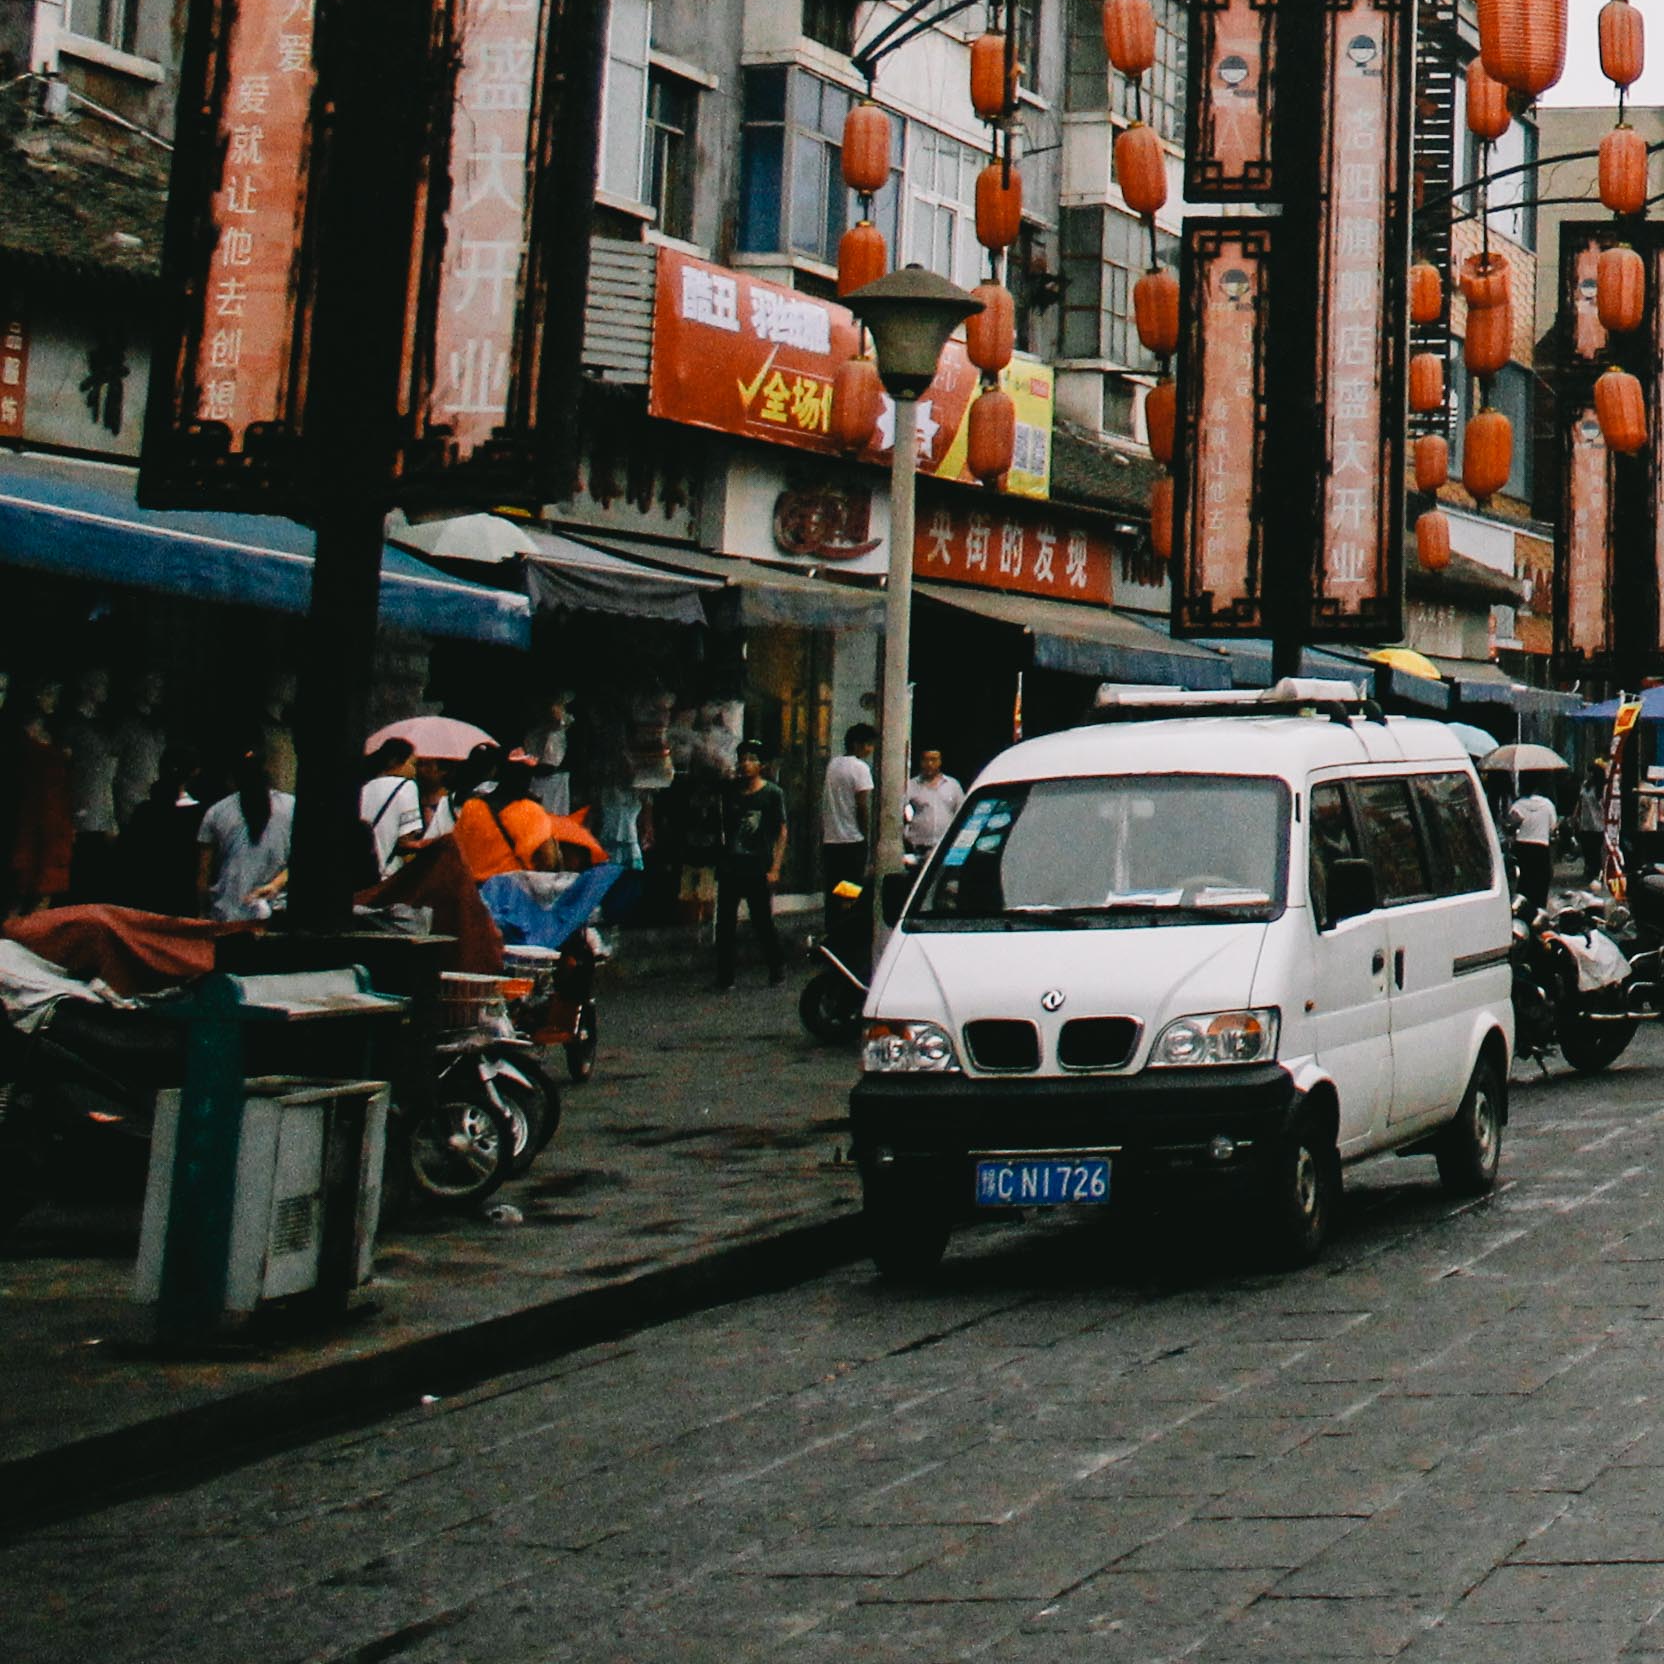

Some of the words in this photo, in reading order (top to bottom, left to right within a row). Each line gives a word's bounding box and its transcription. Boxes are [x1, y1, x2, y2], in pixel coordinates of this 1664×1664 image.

[204, 74, 271, 419] 爱就让他去创想
